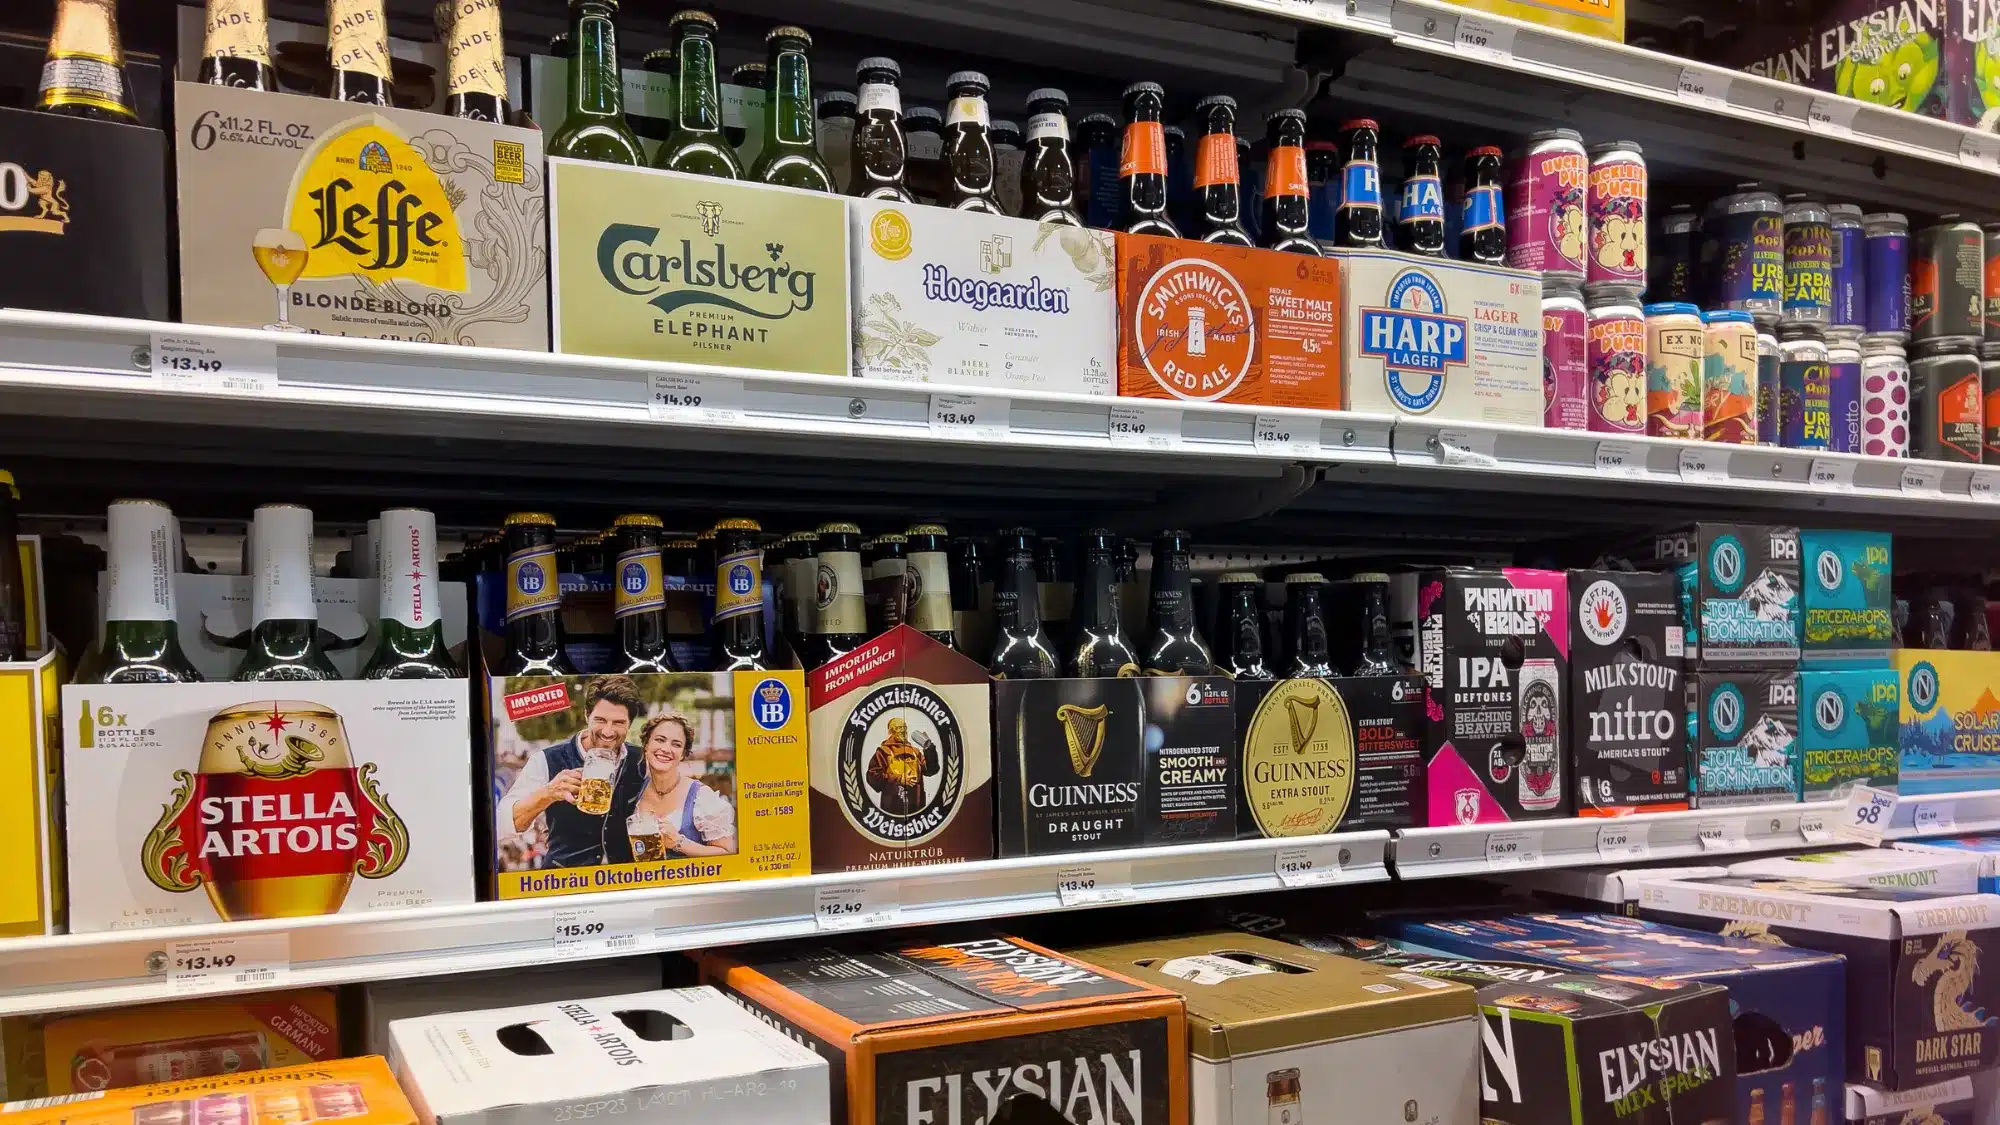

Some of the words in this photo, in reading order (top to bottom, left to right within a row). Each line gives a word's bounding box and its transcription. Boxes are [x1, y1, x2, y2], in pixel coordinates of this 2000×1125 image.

[1461, 32, 1487, 47] $11.99
[1821, 0, 1938, 70] ELYSIAN
[1680, 82, 1704, 95] $13.49
[258, 120, 283, 137] FL.
[219, 132, 244, 144] 6.6%
[496, 151, 521, 161] BEER
[308, 178, 444, 272] Leffe
[597, 223, 816, 314] Carlsberg
[923, 264, 1070, 315] Hoegaarden
[1510, 283, 1522, 295] 6X
[1268, 294, 1305, 312] SWEET
[1305, 298, 1333, 316] MALT
[690, 311, 735, 322] PREMIUM
[1280, 308, 1305, 320] MILD
[1306, 312, 1333, 325] HOPS
[1473, 307, 1521, 325] LAGER
[654, 319, 769, 344] ELEPHANT
[1156, 328, 1180, 338] IRISH
[1213, 333, 1237, 343] MADE
[1371, 315, 1463, 356] HARP
[1473, 324, 1492, 336] CRISP
[1498, 327, 1518, 339] CLEAN
[1518, 329, 1538, 340] FINISH
[1666, 335, 1683, 345] EX
[693, 342, 733, 351] PILSNER
[1302, 338, 1321, 354] 4.5%
[162, 356, 223, 374] $13.49
[1004, 361, 1014, 370] &
[1090, 356, 1103, 368] 6x
[1393, 352, 1440, 369] LAGER
[1162, 359, 1197, 390] RED
[1202, 363, 1232, 390] ALE
[656, 393, 702, 407] $14.99
[937, 412, 976, 426] $13.49
[1111, 421, 1146, 434] $13.49
[1258, 430, 1290, 442] $13.49
[1598, 455, 1623, 466] $11.49
[1681, 461, 1706, 472] $14.99
[413, 527, 421, 568] ARTOIS
[1771, 538, 1797, 561] IPA
[1866, 547, 1888, 566] IPA
[414, 584, 423, 622] STELLA
[1464, 587, 1553, 612] PHANTOM
[1708, 599, 1756, 623] TOTAL
[1810, 609, 1888, 626] TRICERAHOPS
[1586, 618, 1615, 639] BREWING
[1708, 620, 1795, 643] DOMINATION
[825, 646, 879, 681] IMPORTED
[825, 671, 853, 693] FROM
[855, 649, 896, 678] MUNICH
[1459, 656, 1510, 688] IPA
[1584, 663, 1626, 694] MILK
[1628, 661, 1678, 692] STOUT
[510, 688, 564, 710] IMPORTED
[1185, 683, 1202, 705] 6
[1391, 680, 1405, 701] 6
[1454, 691, 1512, 703] DEFTONES
[1770, 684, 1796, 706] IPA
[1872, 684, 1898, 705] IPA
[96, 705, 128, 728] 6x
[760, 703, 785, 724] HB
[850, 686, 951, 731] Franziskaner
[1454, 710, 1512, 724] BELCHING
[1359, 719, 1376, 727] EXTRA
[1376, 717, 1394, 726] STOUT
[1589, 694, 1675, 742] nitro
[1954, 711, 1999, 731] SOLAR
[97, 727, 156, 738] BOTTLES
[214, 719, 257, 752] ANNO
[298, 718, 337, 747] 1366
[1359, 727, 1394, 741] BOLD
[1454, 721, 1512, 735] BEAVER
[747, 734, 798, 746] MÜNCHEN
[1312, 742, 1328, 753] 1759
[1359, 739, 1420, 752] BITTERSWEET
[1159, 747, 1202, 756] NITROGENATED
[1202, 746, 1221, 755] STOUT
[1597, 749, 1640, 760] AMERICA'S
[1707, 748, 1751, 768] TOTAL
[1807, 746, 1896, 766] TRICERAHOPS
[1159, 756, 1214, 769] SMOOTH
[1159, 768, 1227, 785] CREAMY
[1254, 760, 1346, 784] GUINNESS
[1706, 766, 1793, 791] DOMINATION
[743, 782, 756, 791] The
[757, 780, 784, 791] Original
[785, 779, 805, 788] Brew
[1270, 787, 1301, 800] EXTRA
[1301, 785, 1330, 798] STOUT
[1602, 780, 1611, 797] 6
[744, 791, 751, 800] of
[752, 790, 783, 801] Bavarian
[783, 789, 804, 801] Kings
[1028, 783, 1139, 809] GUINNESS
[199, 791, 358, 826] STELLA
[755, 807, 772, 818] est.
[774, 805, 795, 816] 1589
[1855, 804, 1882, 826] 98
[862, 805, 944, 838] Weissbier
[1048, 819, 1124, 834] DRAUGHT
[1801, 823, 1824, 832] $12.49
[197, 822, 359, 859] ARTOIS
[1071, 833, 1102, 842] STOUT
[1602, 836, 1628, 847] $17.99
[1699, 830, 1723, 840] $12.49
[869, 847, 943, 862] NATURTRÜB
[1490, 842, 1518, 854] $16.99
[1280, 860, 1312, 873] $13.49
[519, 870, 589, 892] Hofbräu
[594, 861, 723, 886] Oktoberfestbier
[376, 888, 424, 898] PREMIUM
[1060, 879, 1095, 892] $13.49
[122, 909, 140, 918] LA
[820, 902, 862, 916] $12.49
[1697, 897, 1811, 930] FREMONT
[1915, 905, 1989, 929] FREMONT
[556, 923, 604, 938] $15.99
[1904, 940, 1913, 956] 6
[176, 954, 236, 971] $13.49
[288, 1003, 330, 1036] IMPORTED
[291, 1017, 317, 1038] FROM
[270, 1015, 326, 1057] GERMANY
[556, 1003, 592, 1027] STELLA
[593, 1031, 644, 1067] ARTOIS
[1915, 1035, 1948, 1063] DARK
[1950, 1032, 1982, 1059] STAR
[1598, 1027, 1722, 1103] ELYSIAN
[1612, 1086, 1656, 1119] MIX
[1659, 1064, 1714, 1101] PACK
[553, 1099, 628, 1123] 23SEP23
